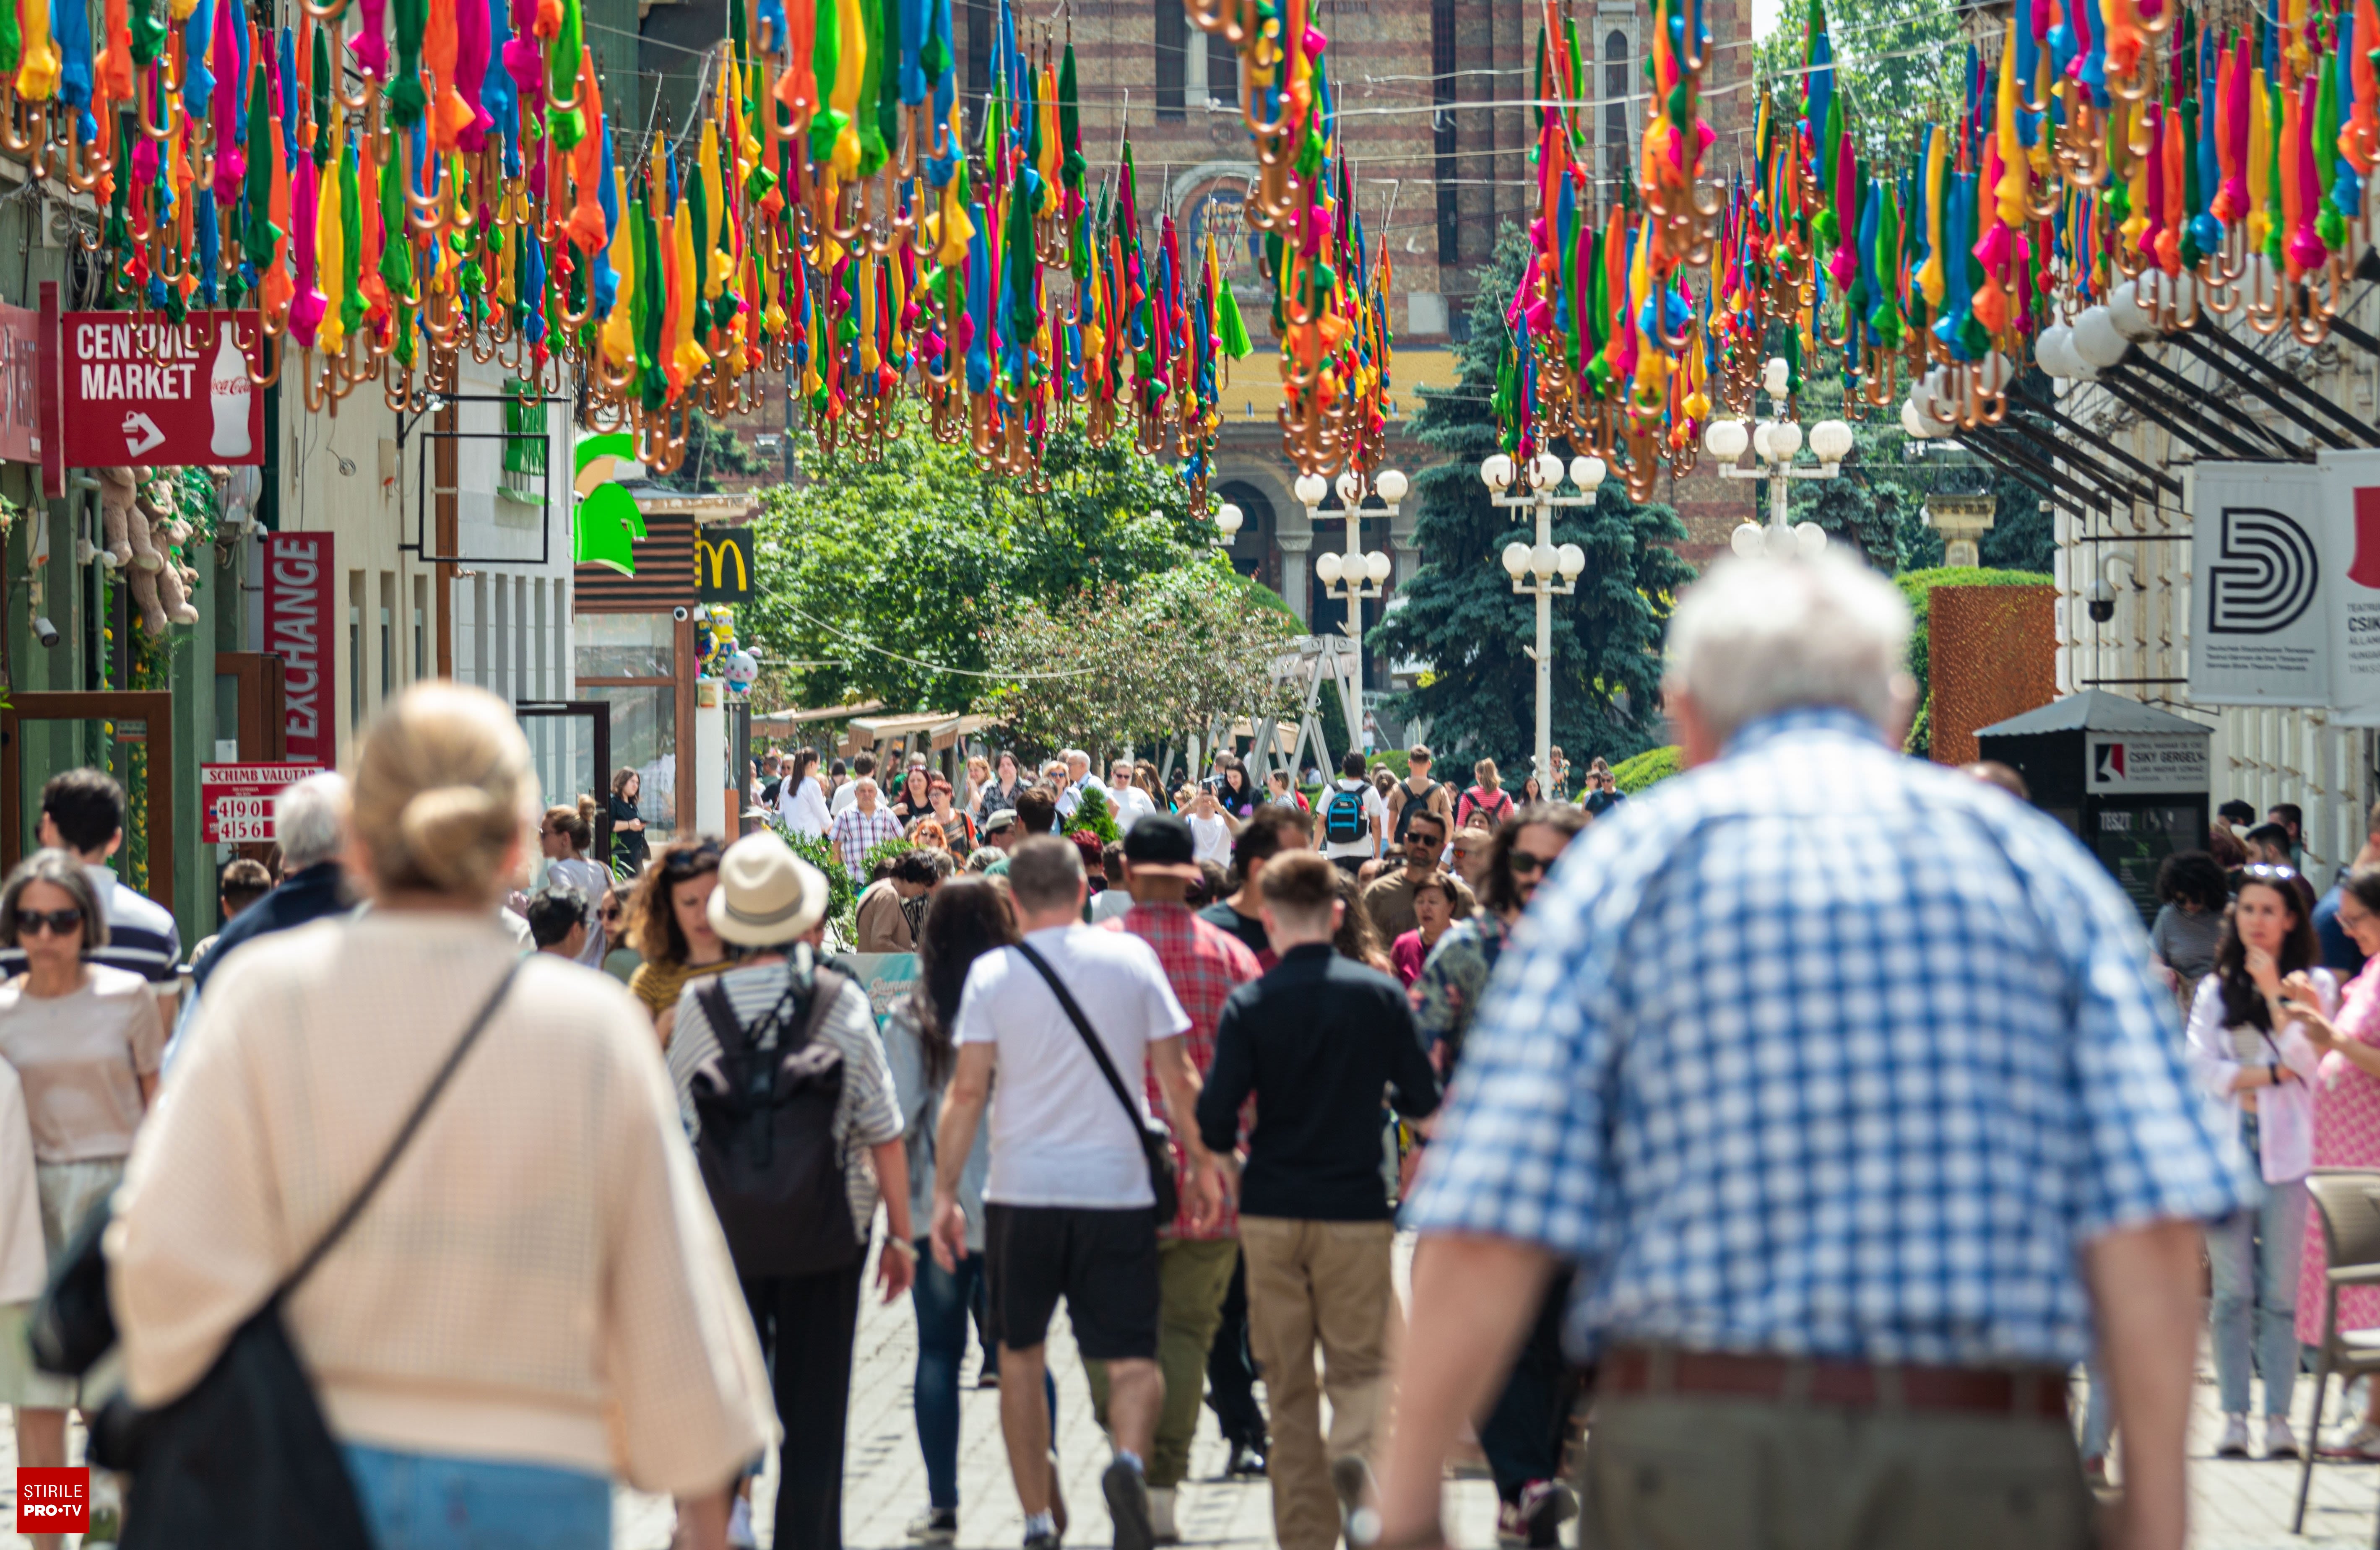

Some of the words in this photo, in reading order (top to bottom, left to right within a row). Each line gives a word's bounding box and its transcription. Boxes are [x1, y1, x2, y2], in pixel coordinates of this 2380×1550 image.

[77, 323, 200, 360] CENTRAL
[81, 363, 196, 400] MARKET
[273, 538, 319, 738] EXCHANGE
[210, 770, 259, 782] SCHIMB
